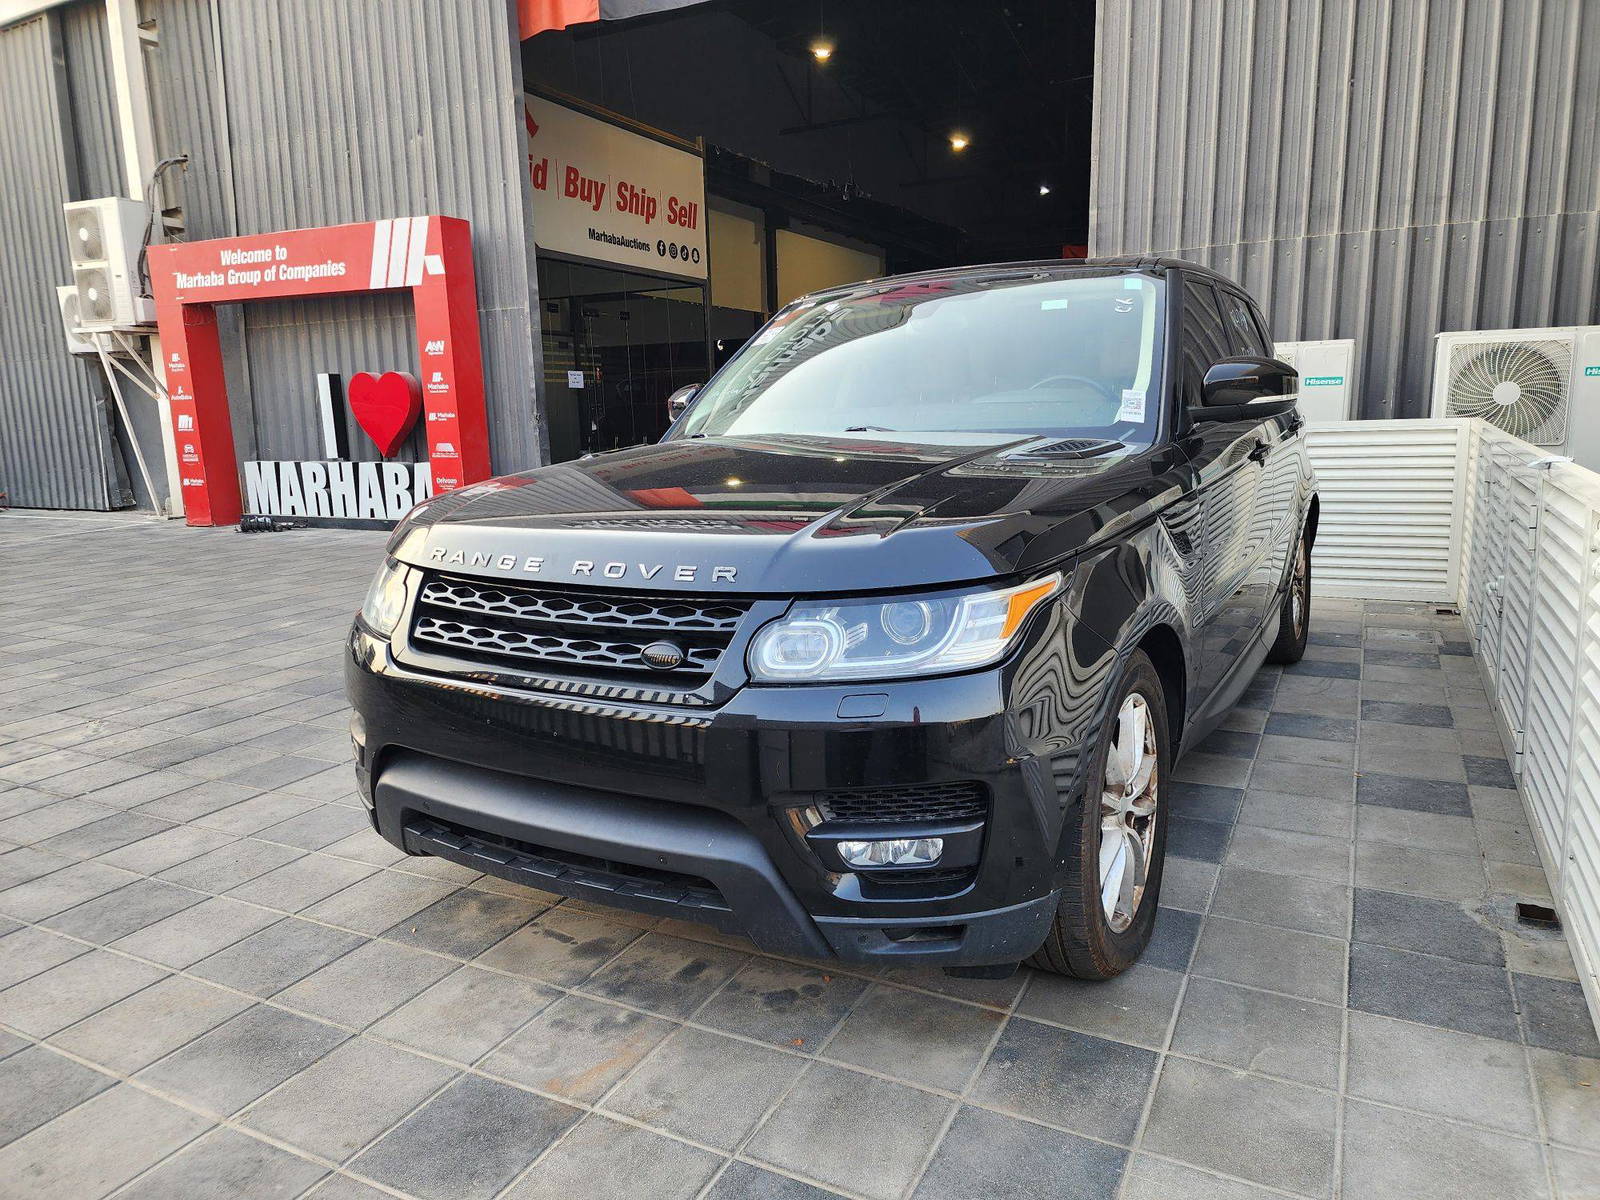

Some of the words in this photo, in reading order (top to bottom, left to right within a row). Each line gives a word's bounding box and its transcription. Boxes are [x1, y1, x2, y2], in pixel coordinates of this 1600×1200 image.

[528, 154, 548, 190] id
[564, 165, 606, 212] Buy
[616, 181, 657, 225] Ship
[667, 196, 698, 230] Sell
[588, 227, 651, 252] MarhabaAuctions
[220, 248, 272, 266] Welcome
[275, 245, 287, 260] to
[175, 272, 225, 289] Marhaba
[227, 269, 261, 286] Group
[264, 265, 277, 282] of
[279, 260, 346, 282] Companies
[1305, 378, 1342, 386] Hisense
[317, 374, 339, 459] I
[430, 547, 545, 573] RANGE
[571, 560, 738, 584] ROVER
